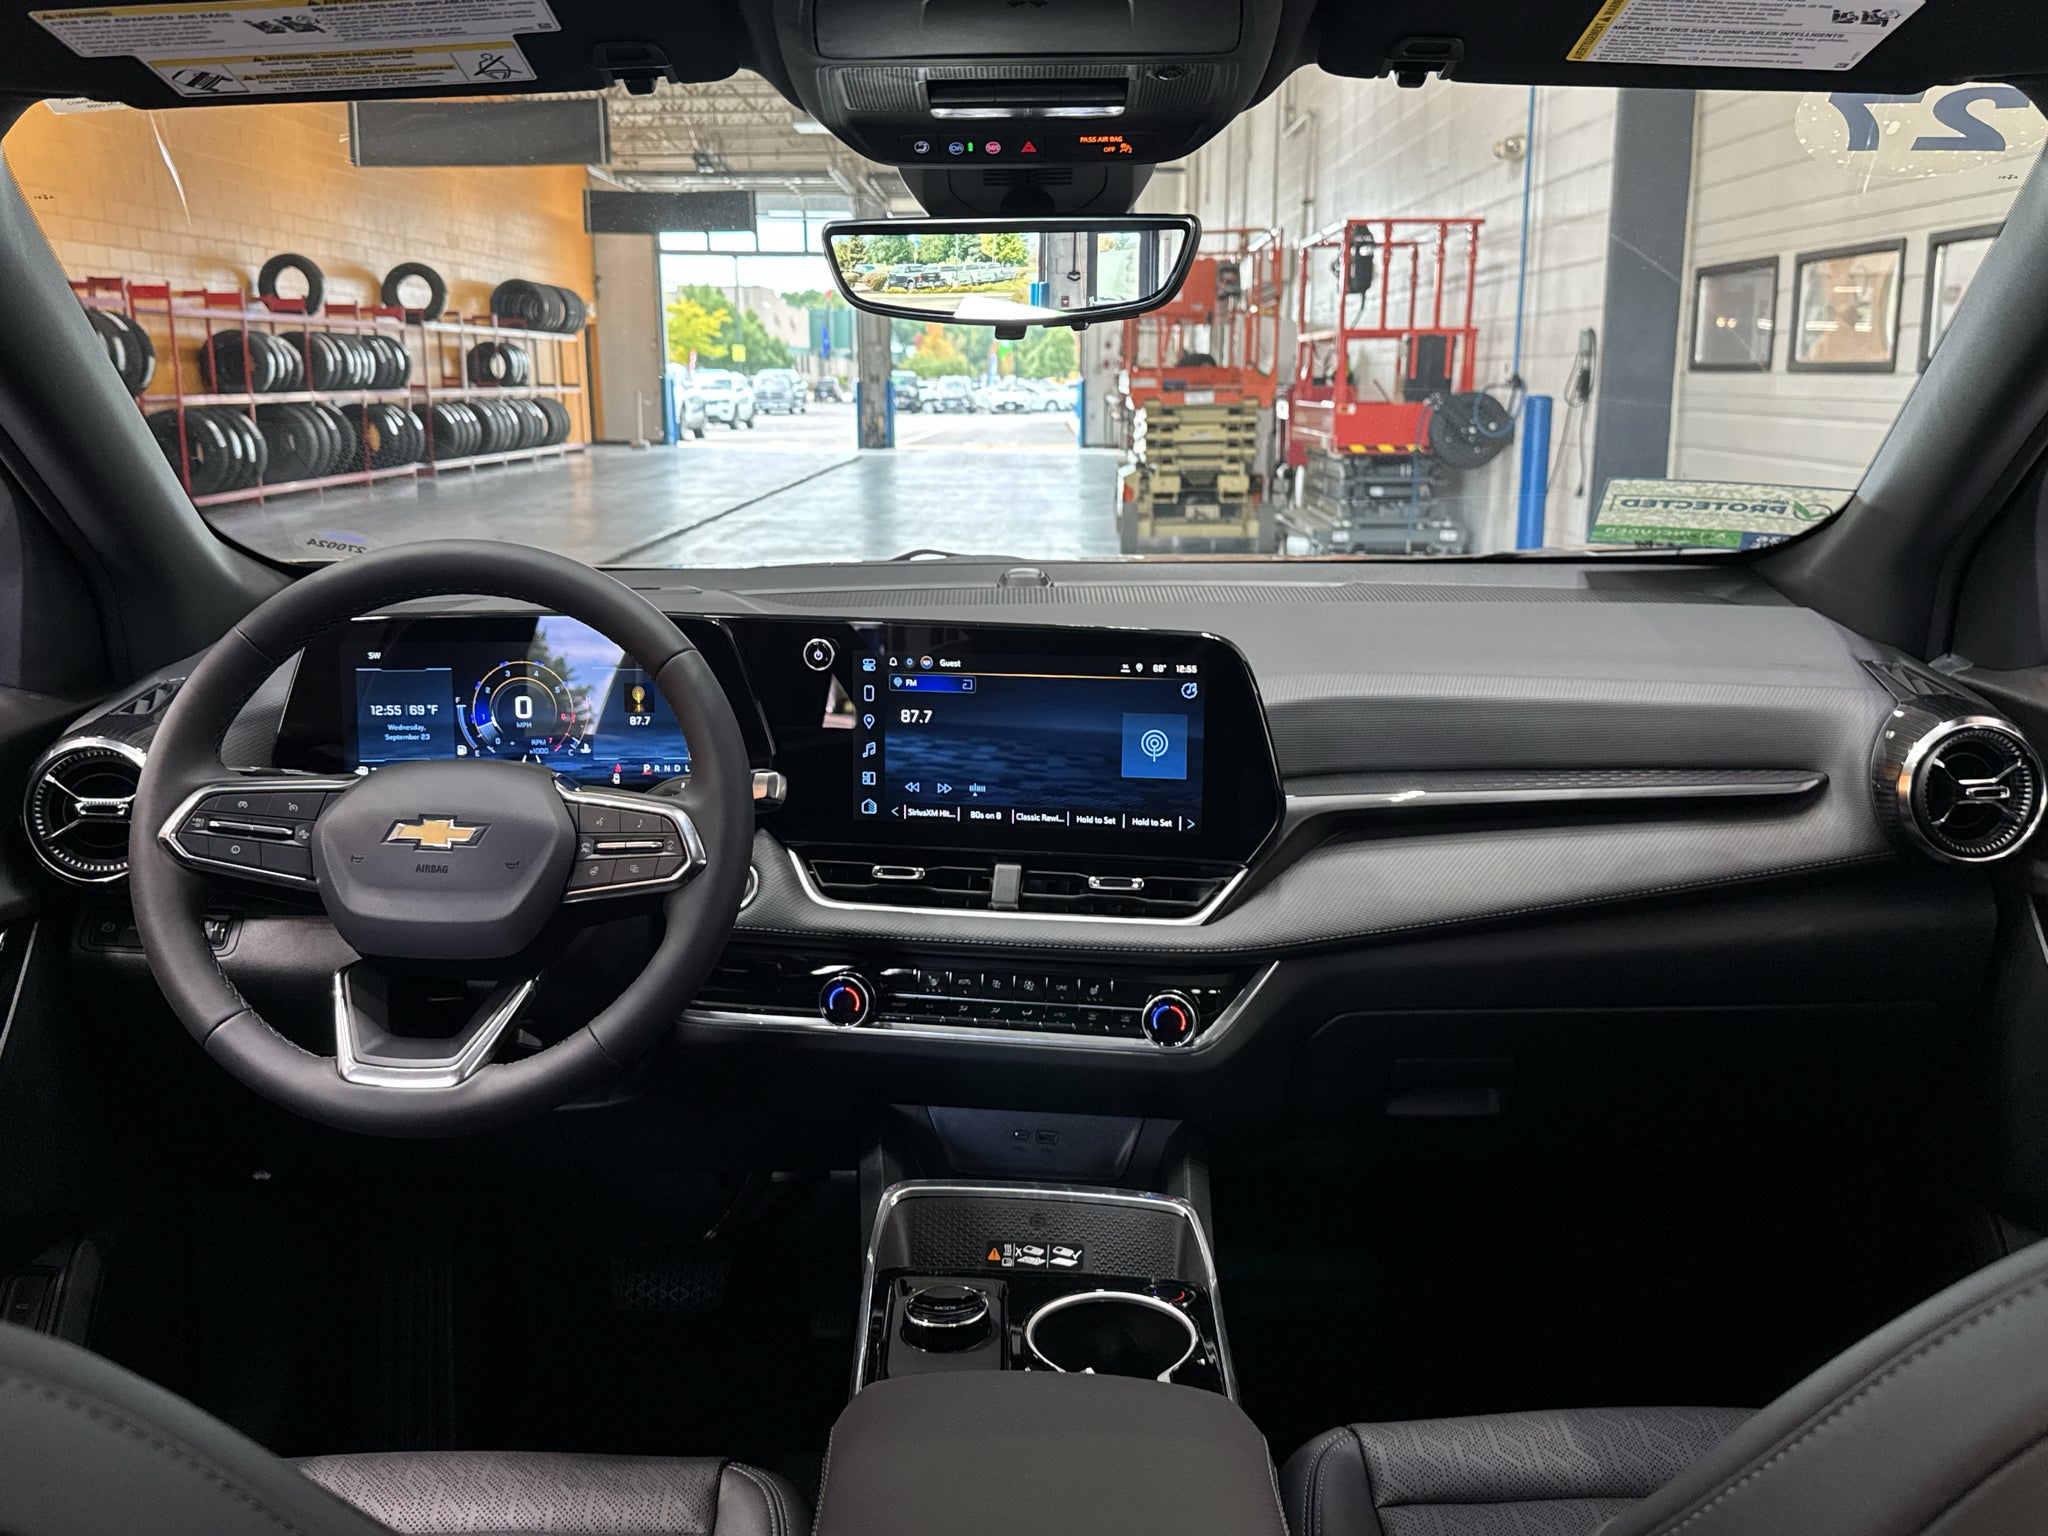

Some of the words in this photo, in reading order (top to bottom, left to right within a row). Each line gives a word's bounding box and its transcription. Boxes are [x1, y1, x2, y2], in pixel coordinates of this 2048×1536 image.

[367, 652, 381, 660] SW
[939, 659, 961, 667] Guest
[1176, 664, 1198, 673] 12:55
[905, 679, 917, 687] FM
[485, 686, 491, 694] 2
[370, 704, 402, 716] 12:55
[409, 704, 426, 716] 69
[426, 704, 439, 715] °F
[515, 695, 533, 719] 0
[629, 716, 651, 726] 87.7
[900, 709, 933, 724] 87.7
[387, 724, 427, 733] Wednesday,
[516, 724, 532, 732] MPH
[384, 733, 420, 742] September
[420, 733, 431, 741] 23
[531, 738, 547, 746] RPM
[643, 763, 651, 773] P
[654, 764, 660, 772] R
[664, 764, 671, 772] N
[674, 764, 681, 772] D
[684, 764, 691, 772] L
[907, 808, 938, 818] SiriusXM
[1016, 812, 1041, 822] Classic
[1076, 815, 1094, 824] Hold
[1094, 816, 1103, 825] to
[1103, 816, 1117, 825] Set
[1132, 817, 1150, 827] Hold
[1150, 818, 1159, 827] to
[1159, 818, 1173, 828] Set
[415, 863, 449, 874] AIRBAG
